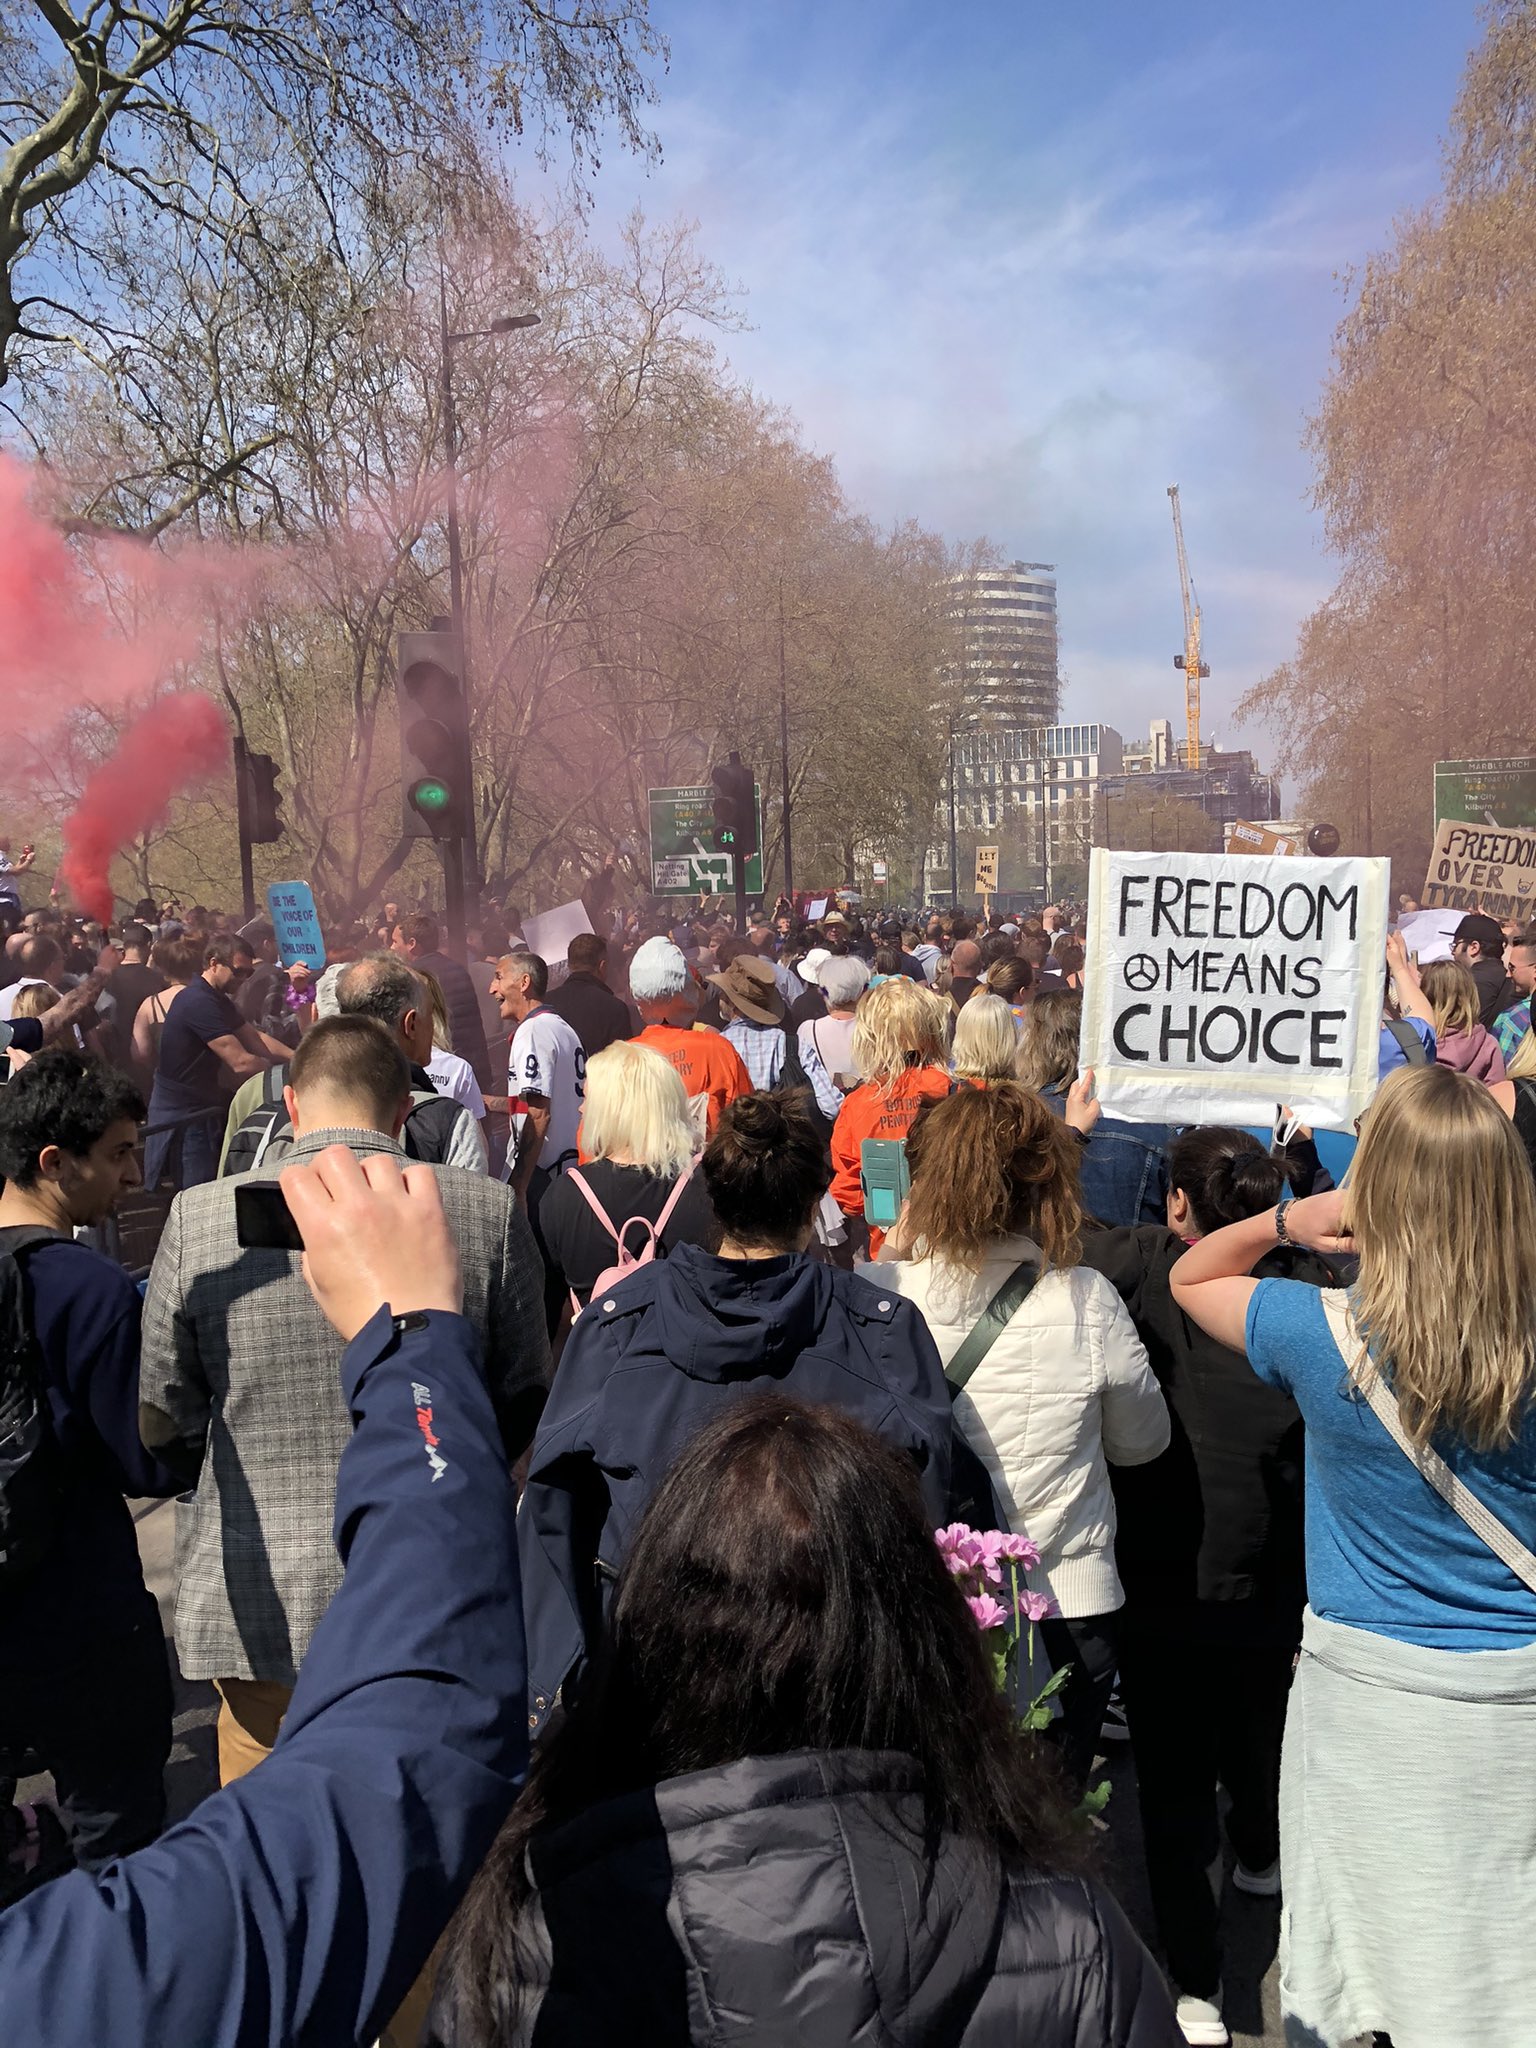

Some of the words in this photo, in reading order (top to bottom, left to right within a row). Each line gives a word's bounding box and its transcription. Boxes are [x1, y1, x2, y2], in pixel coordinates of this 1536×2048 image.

[1468, 762, 1503, 770] MARBLE
[1506, 760, 1530, 769] ARCH
[677, 789, 707, 798] MARBLE
[1480, 793, 1496, 801] City
[1464, 803, 1493, 811] Kilburn
[675, 820, 687, 828] The
[980, 852, 996, 860] LET
[981, 865, 992, 873] ME
[1437, 858, 1504, 890] OVER
[282, 896, 296, 906] THE
[1427, 882, 1532, 919] TYRANNY
[1118, 875, 1358, 941] FREEDOM
[282, 911, 302, 921] VOICE
[303, 910, 313, 921] OF
[287, 927, 302, 937] OUR
[282, 943, 317, 954] CHILDREN
[1166, 948, 1322, 999] MEANS
[1113, 1003, 1347, 1068] CHOICE
[525, 1053, 539, 1079] 9
[428, 1073, 451, 1087] anny
[411, 1382, 432, 1406] ALL
